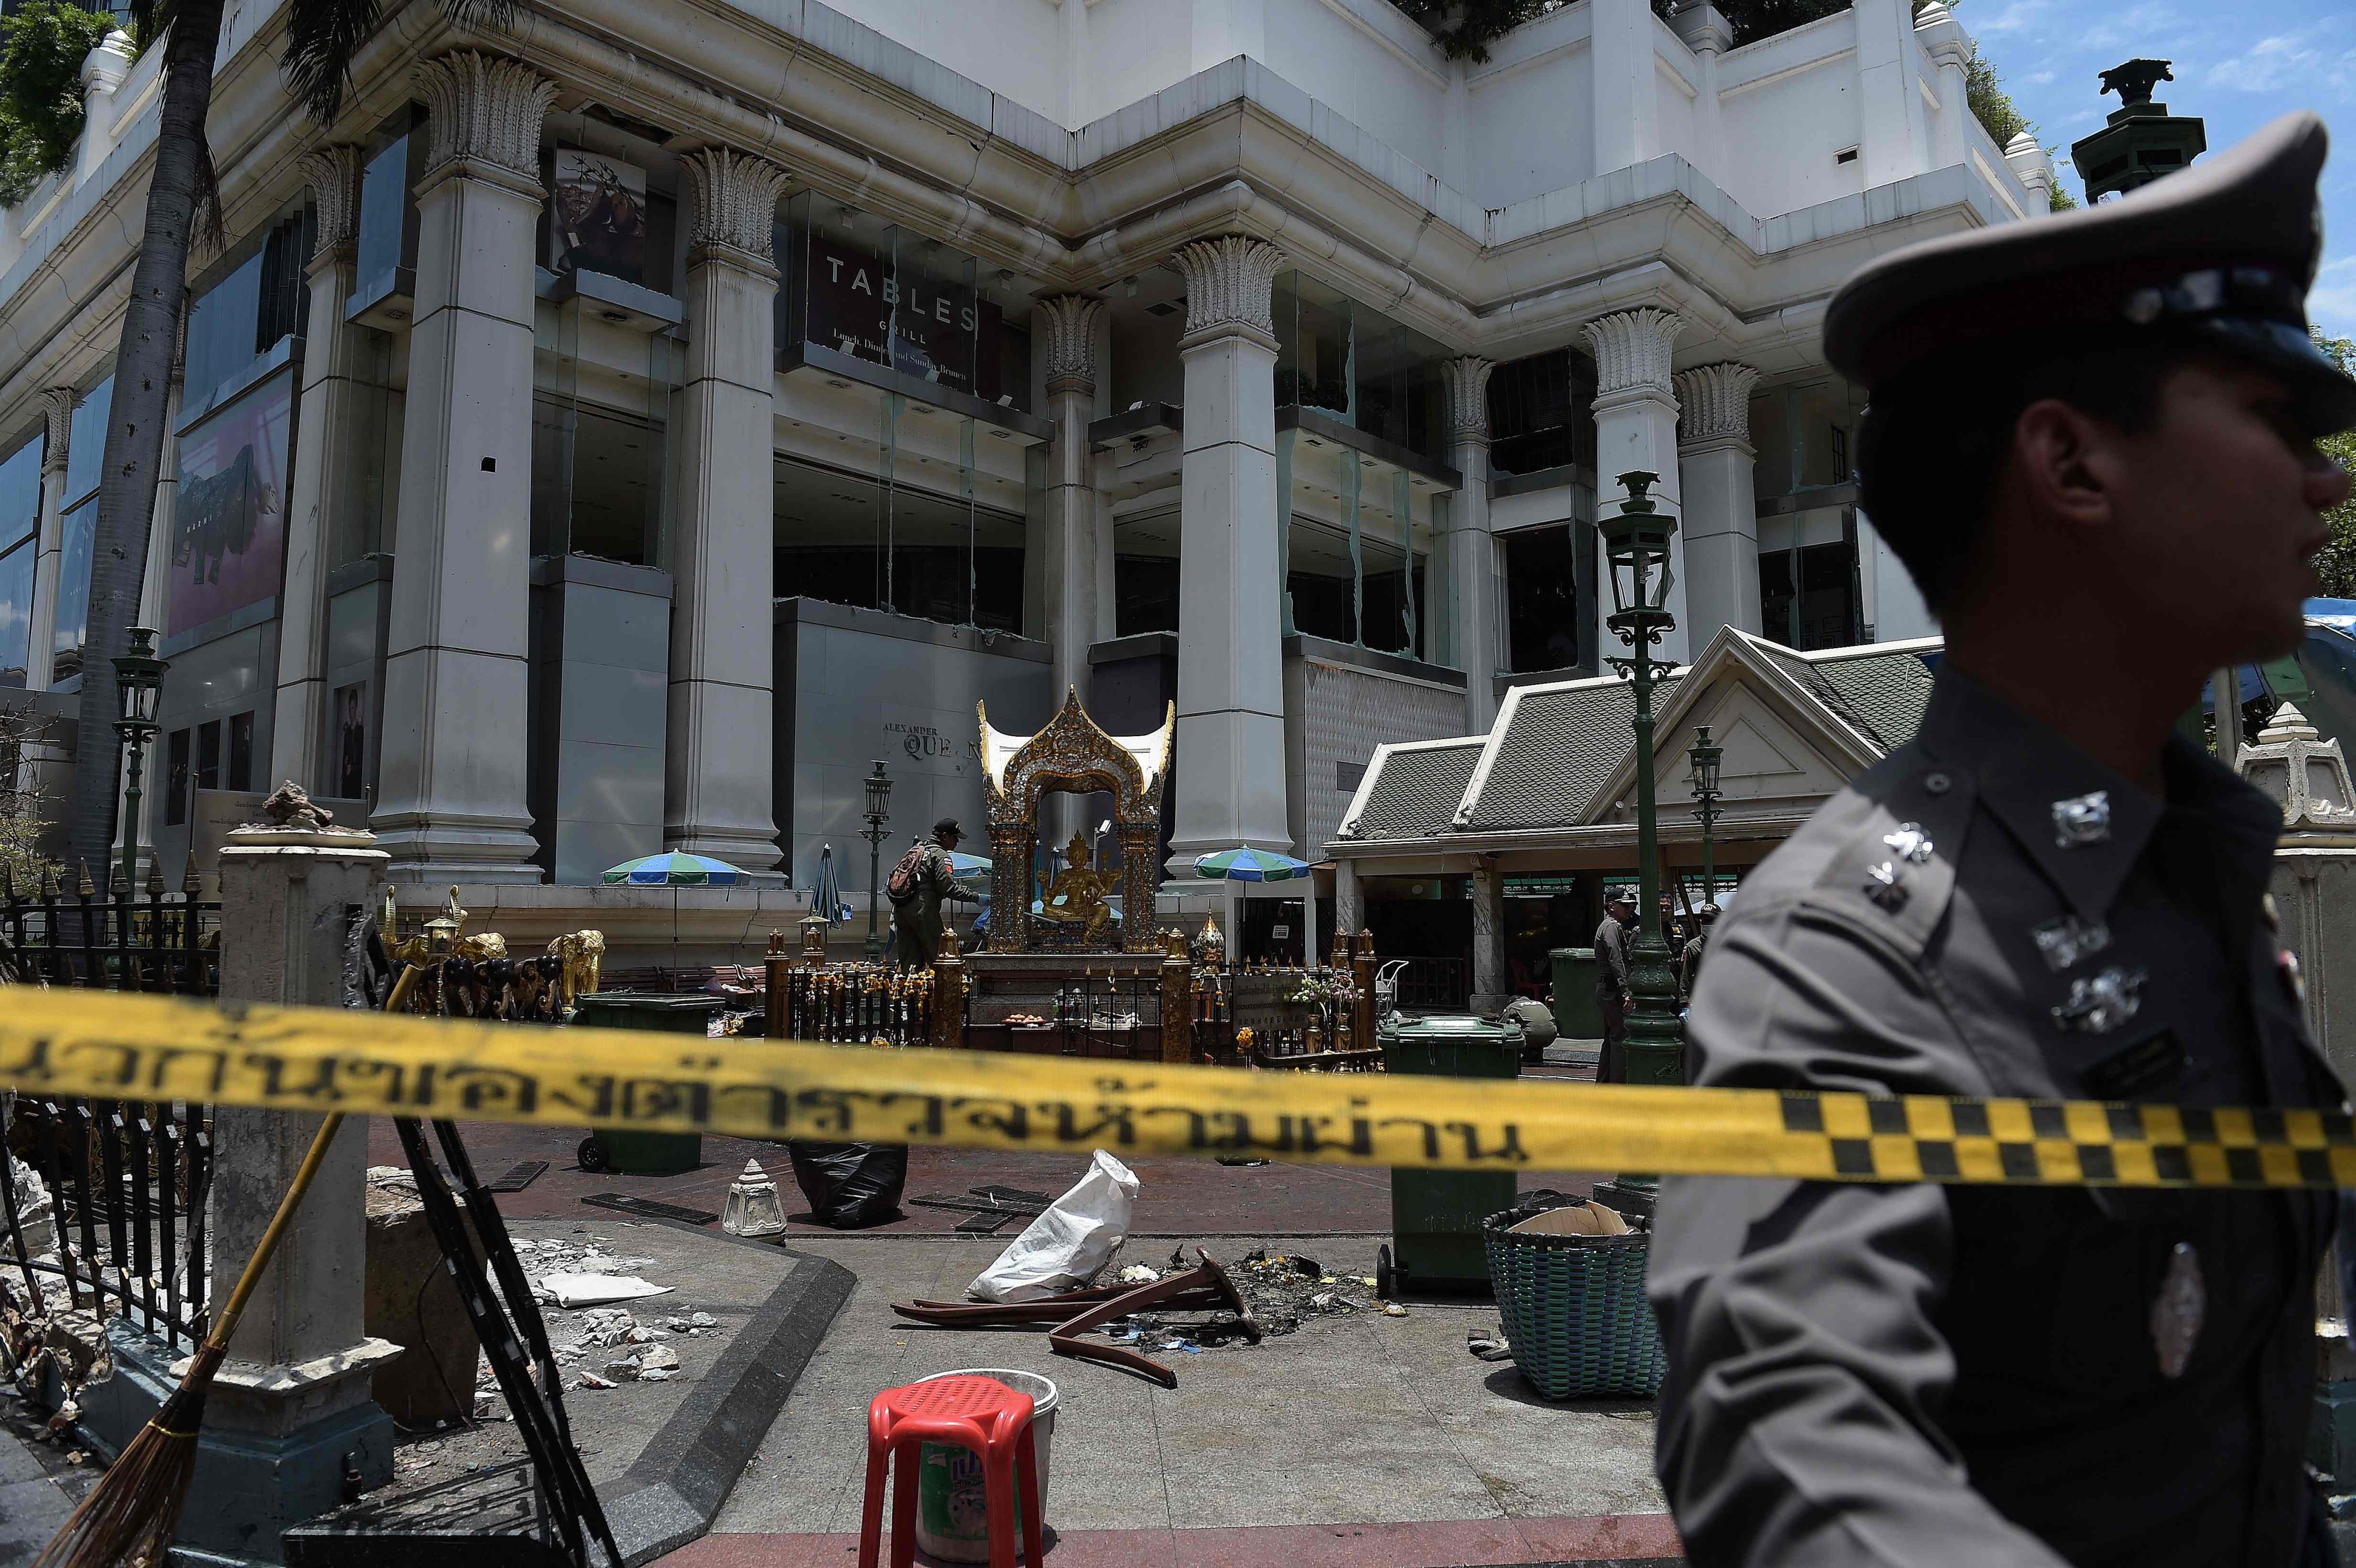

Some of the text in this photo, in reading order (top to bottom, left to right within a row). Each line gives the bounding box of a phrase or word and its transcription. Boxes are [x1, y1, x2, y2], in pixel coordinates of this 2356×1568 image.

[827, 256, 974, 331] TABLES
[879, 320, 926, 344] GRILL
[909, 355, 938, 372] Sunday
[940, 364, 966, 381] Brunch
[883, 722, 938, 736] ALEXANDER
[904, 733, 981, 760] QUEN
